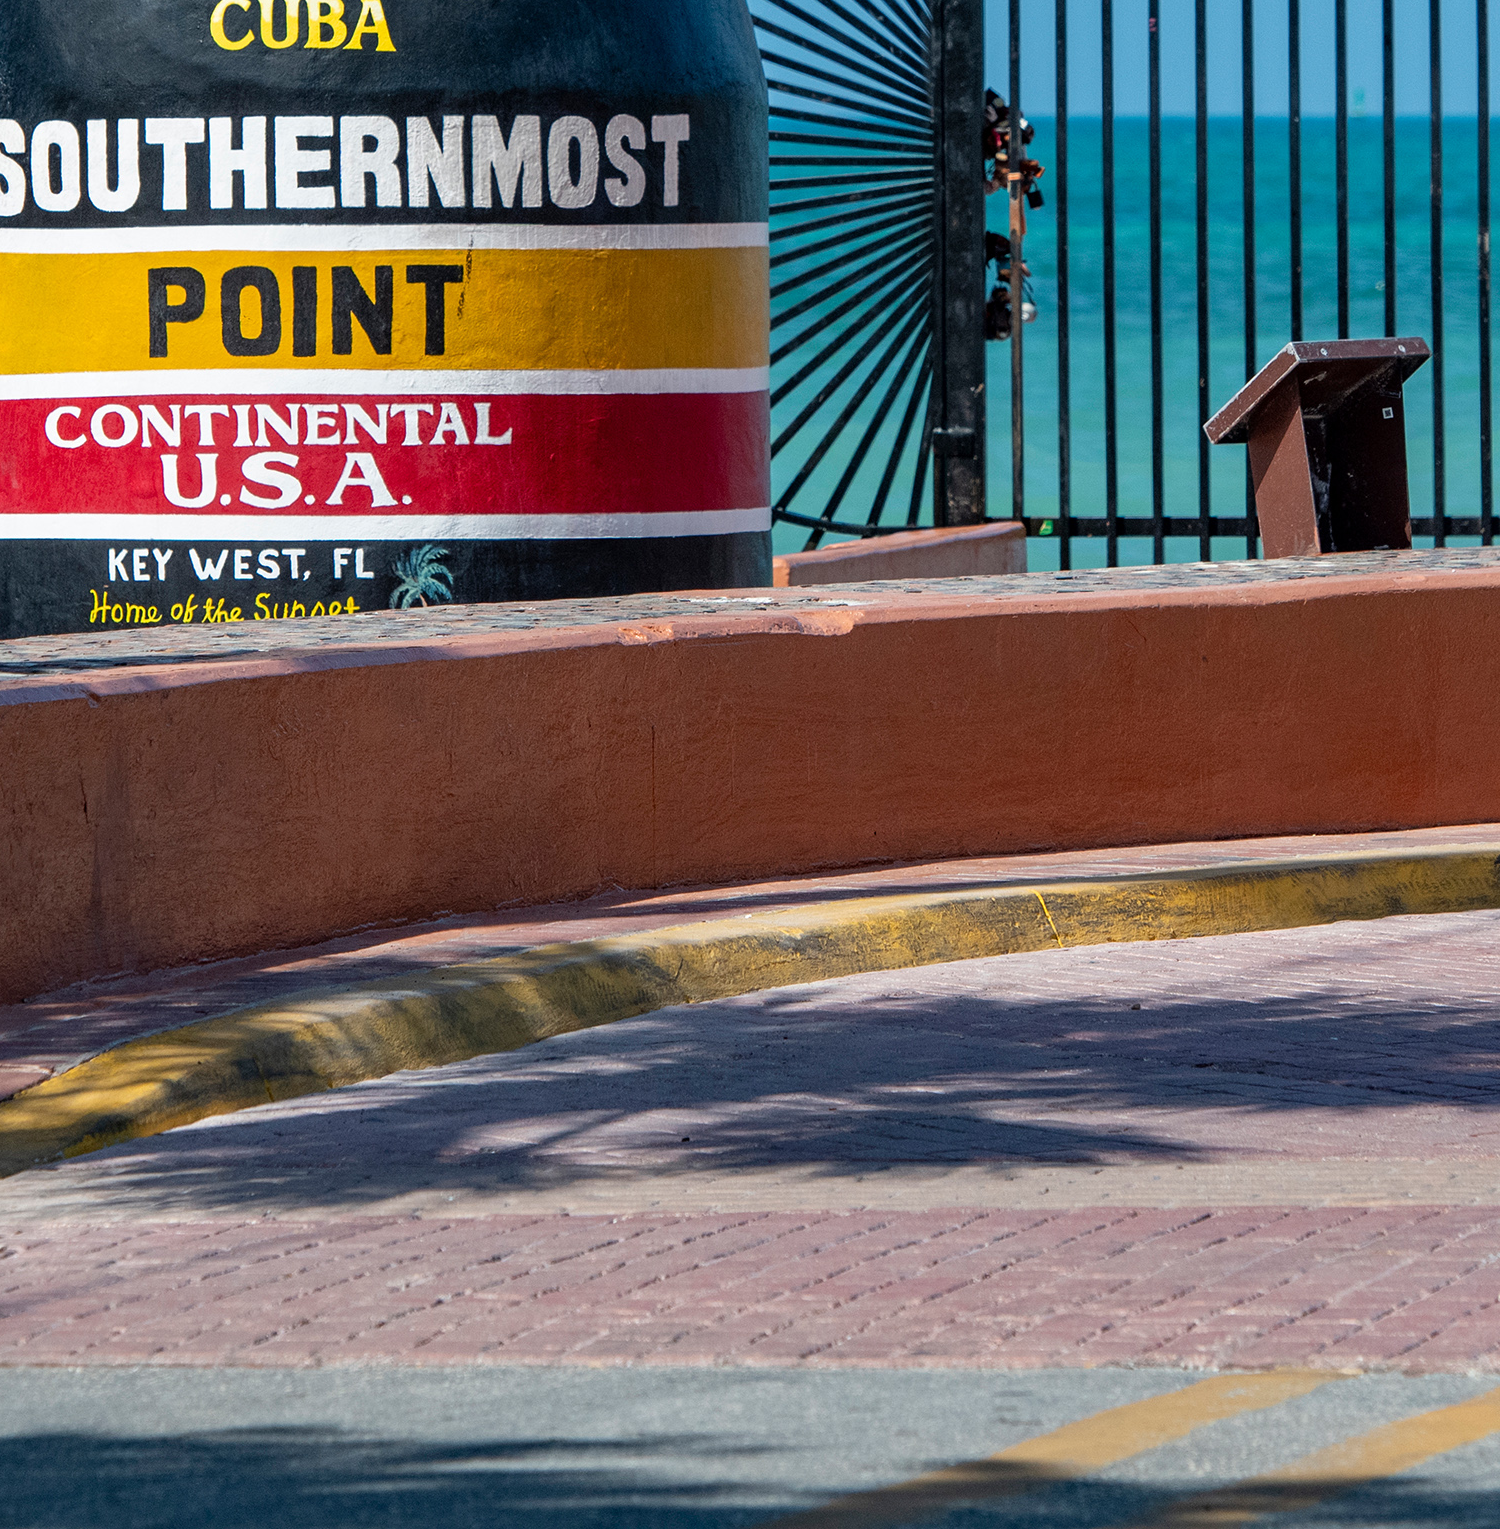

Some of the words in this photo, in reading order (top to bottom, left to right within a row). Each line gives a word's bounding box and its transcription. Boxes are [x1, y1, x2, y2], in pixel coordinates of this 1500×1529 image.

[147, 264, 465, 358] POINT
[44, 401, 513, 449] CONTINENTAL
[159, 450, 413, 510] U.S.A.
[108, 547, 174, 582] KEY
[188, 547, 311, 582] WEST,
[333, 547, 375, 579] FL
[89, 589, 163, 624] Home
[170, 593, 199, 623] of
[202, 597, 245, 623] the
